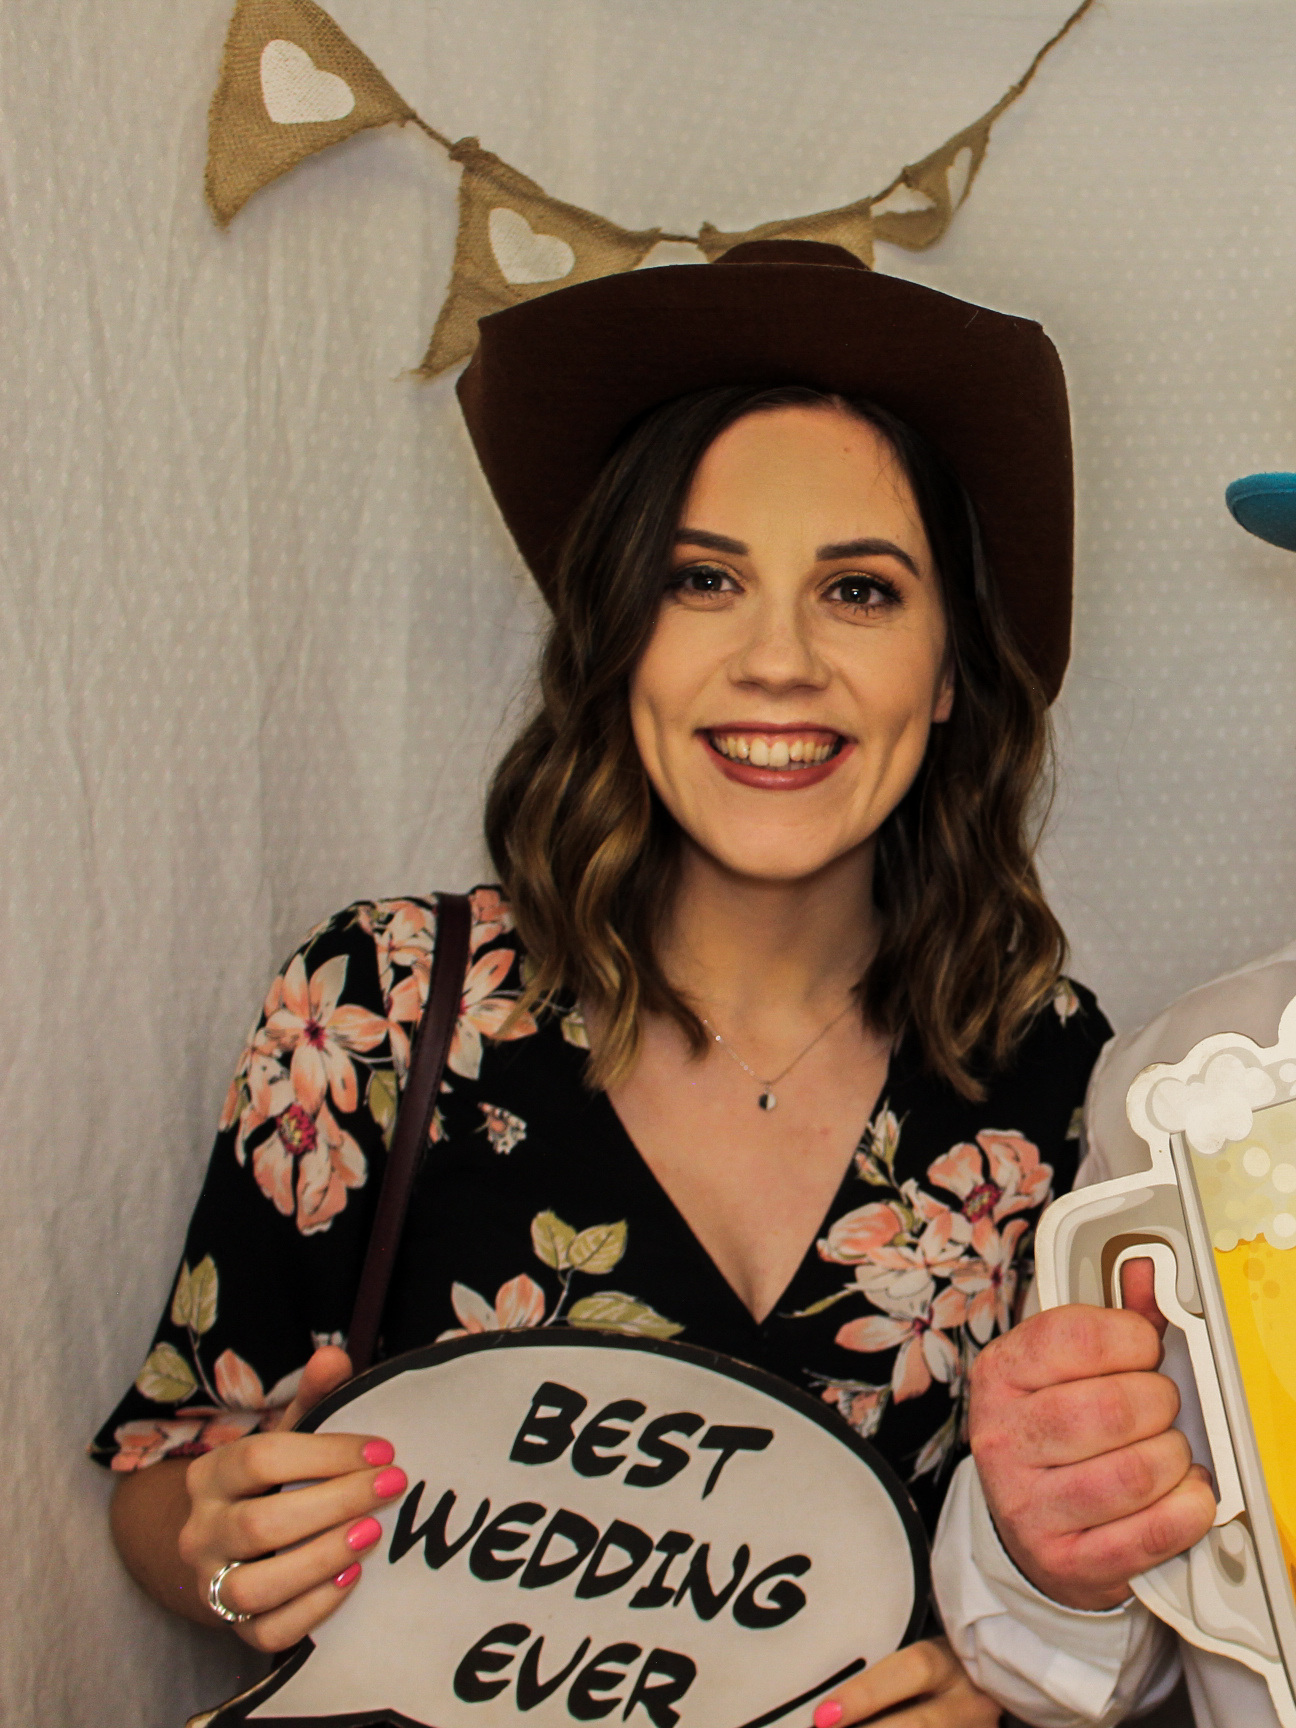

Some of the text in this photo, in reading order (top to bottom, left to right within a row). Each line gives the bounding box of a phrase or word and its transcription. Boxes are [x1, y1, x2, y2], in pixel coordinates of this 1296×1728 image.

[509, 1381, 775, 1500] BEST
[388, 1480, 812, 1630] WEDDING
[453, 1622, 697, 1728] EVER
